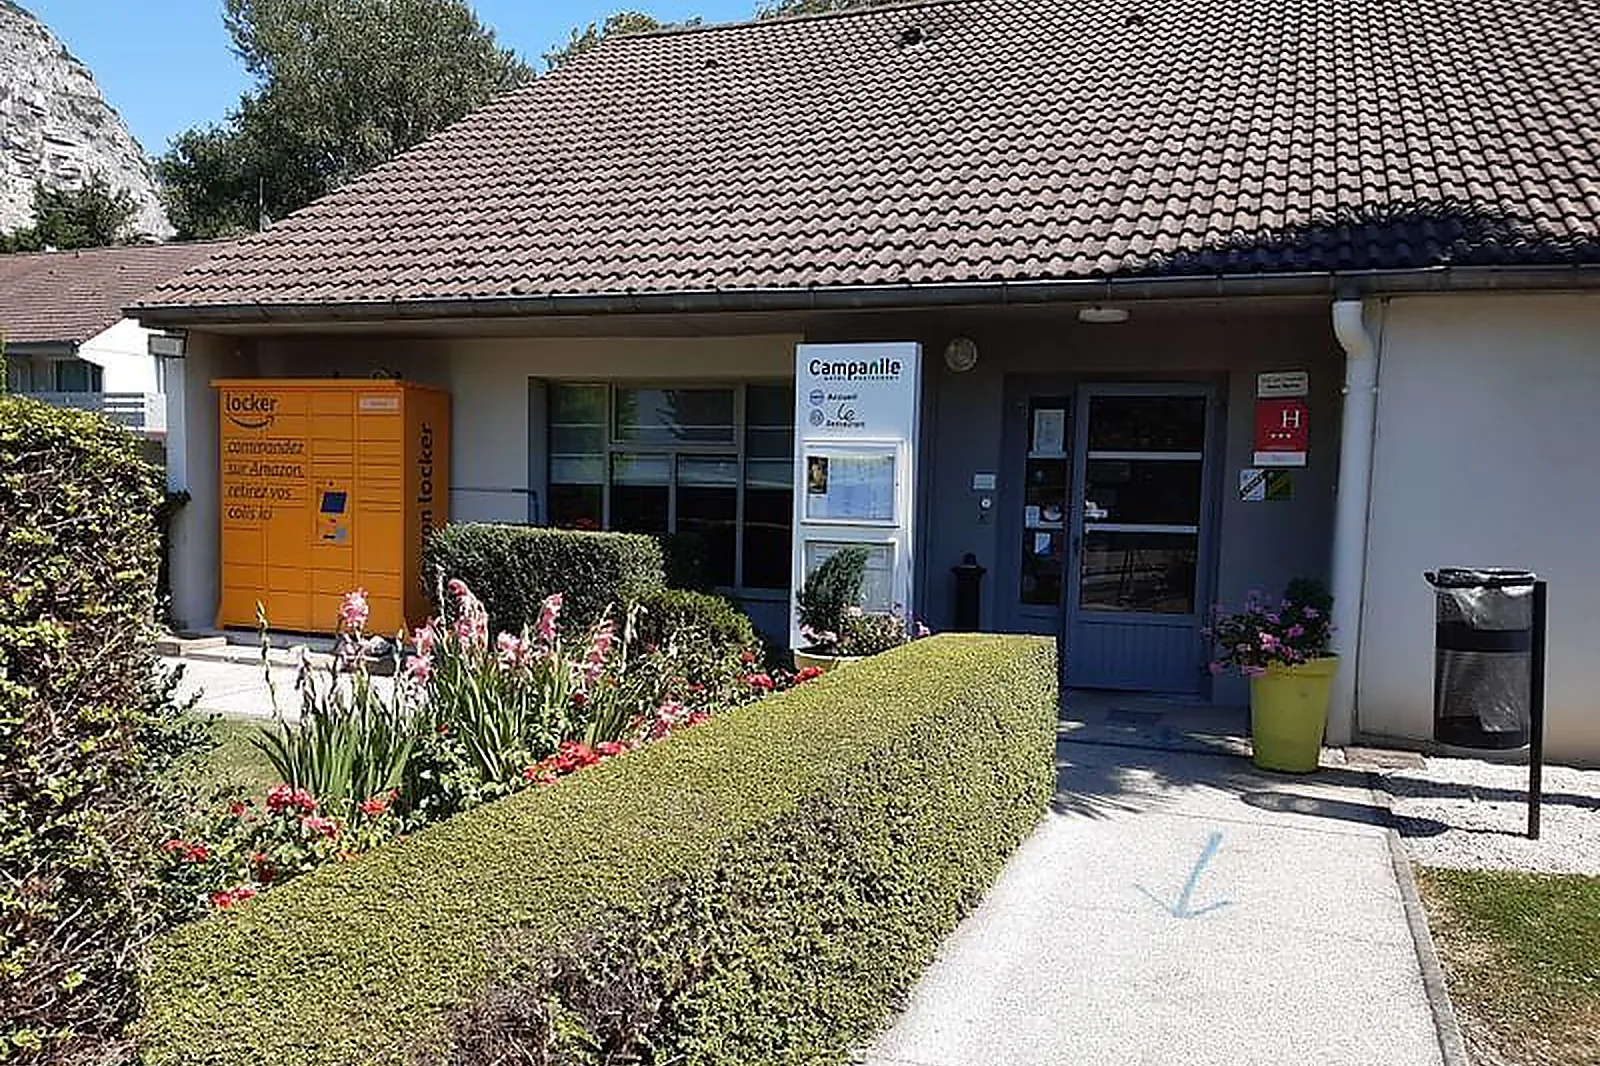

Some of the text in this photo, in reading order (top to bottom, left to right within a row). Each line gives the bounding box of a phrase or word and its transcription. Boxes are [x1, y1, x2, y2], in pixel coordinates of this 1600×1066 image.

[809, 358, 901, 381] Campanile
[226, 392, 277, 412] locker
[1282, 410, 1300, 428] H
[227, 438, 305, 455] commandez
[416, 421, 434, 504] locker
[227, 482, 292, 502] retirez vos
